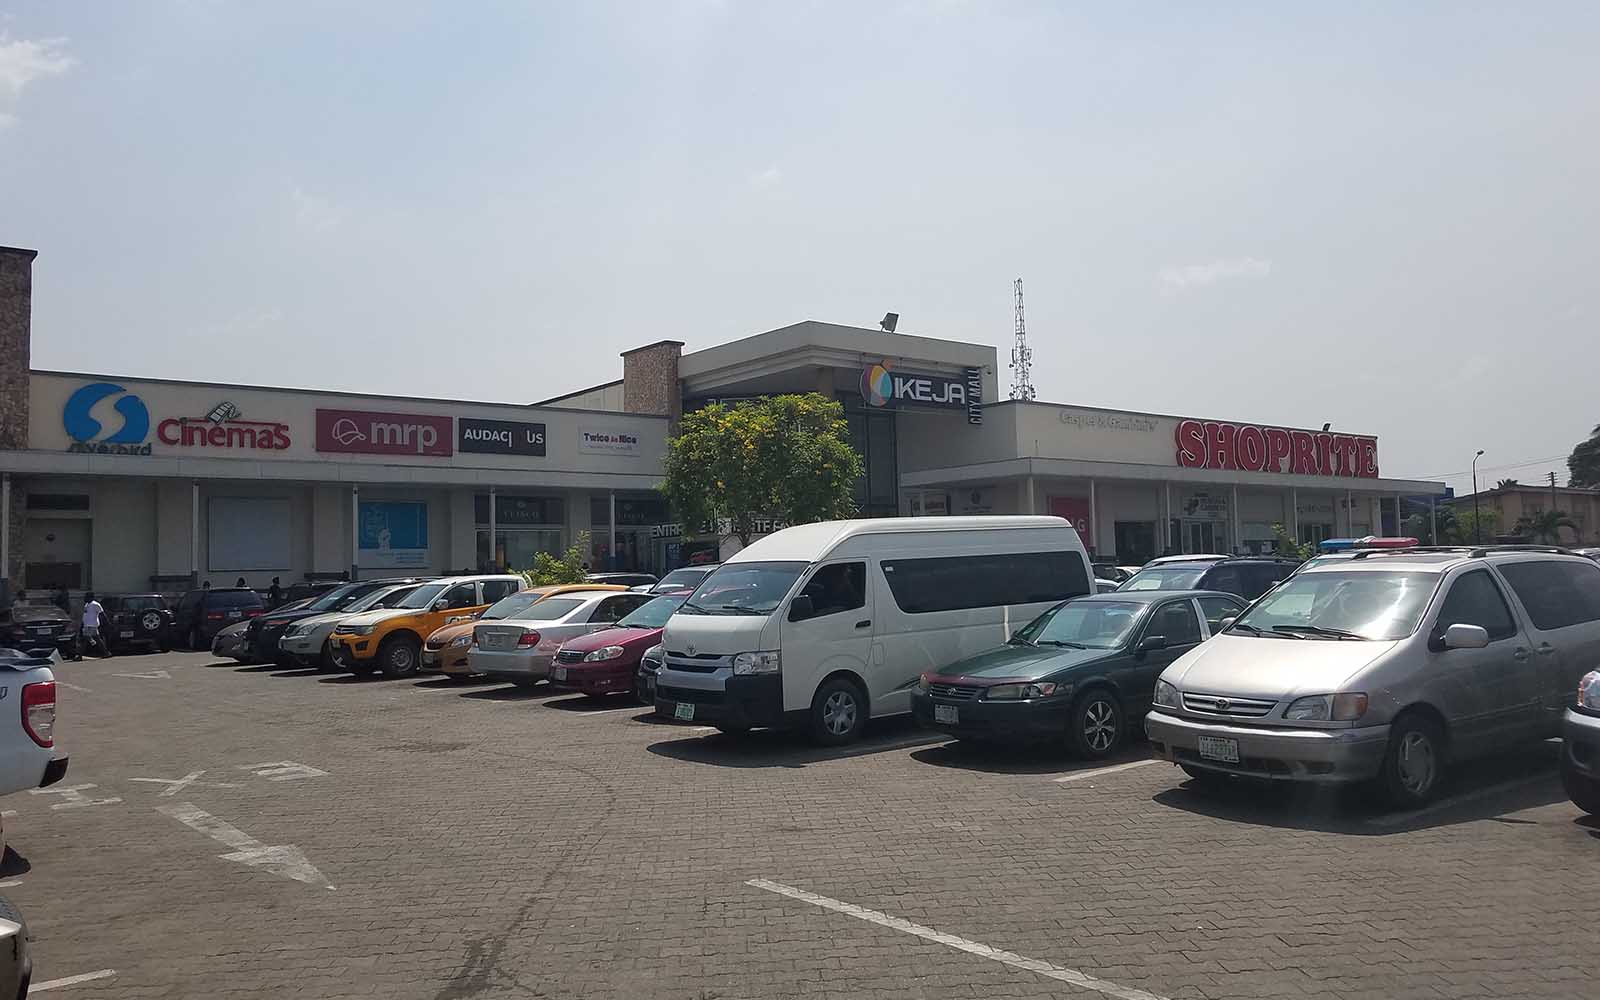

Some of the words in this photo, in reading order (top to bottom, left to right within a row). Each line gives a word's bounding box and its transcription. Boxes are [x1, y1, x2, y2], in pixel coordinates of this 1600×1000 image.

[894, 377, 966, 404] IKEJA
[968, 368, 980, 398] MALL
[968, 401, 982, 424] CITY
[371, 422, 437, 453] mrp
[584, 432, 609, 442] Twice
[1175, 420, 1378, 478] SHOPRITE
